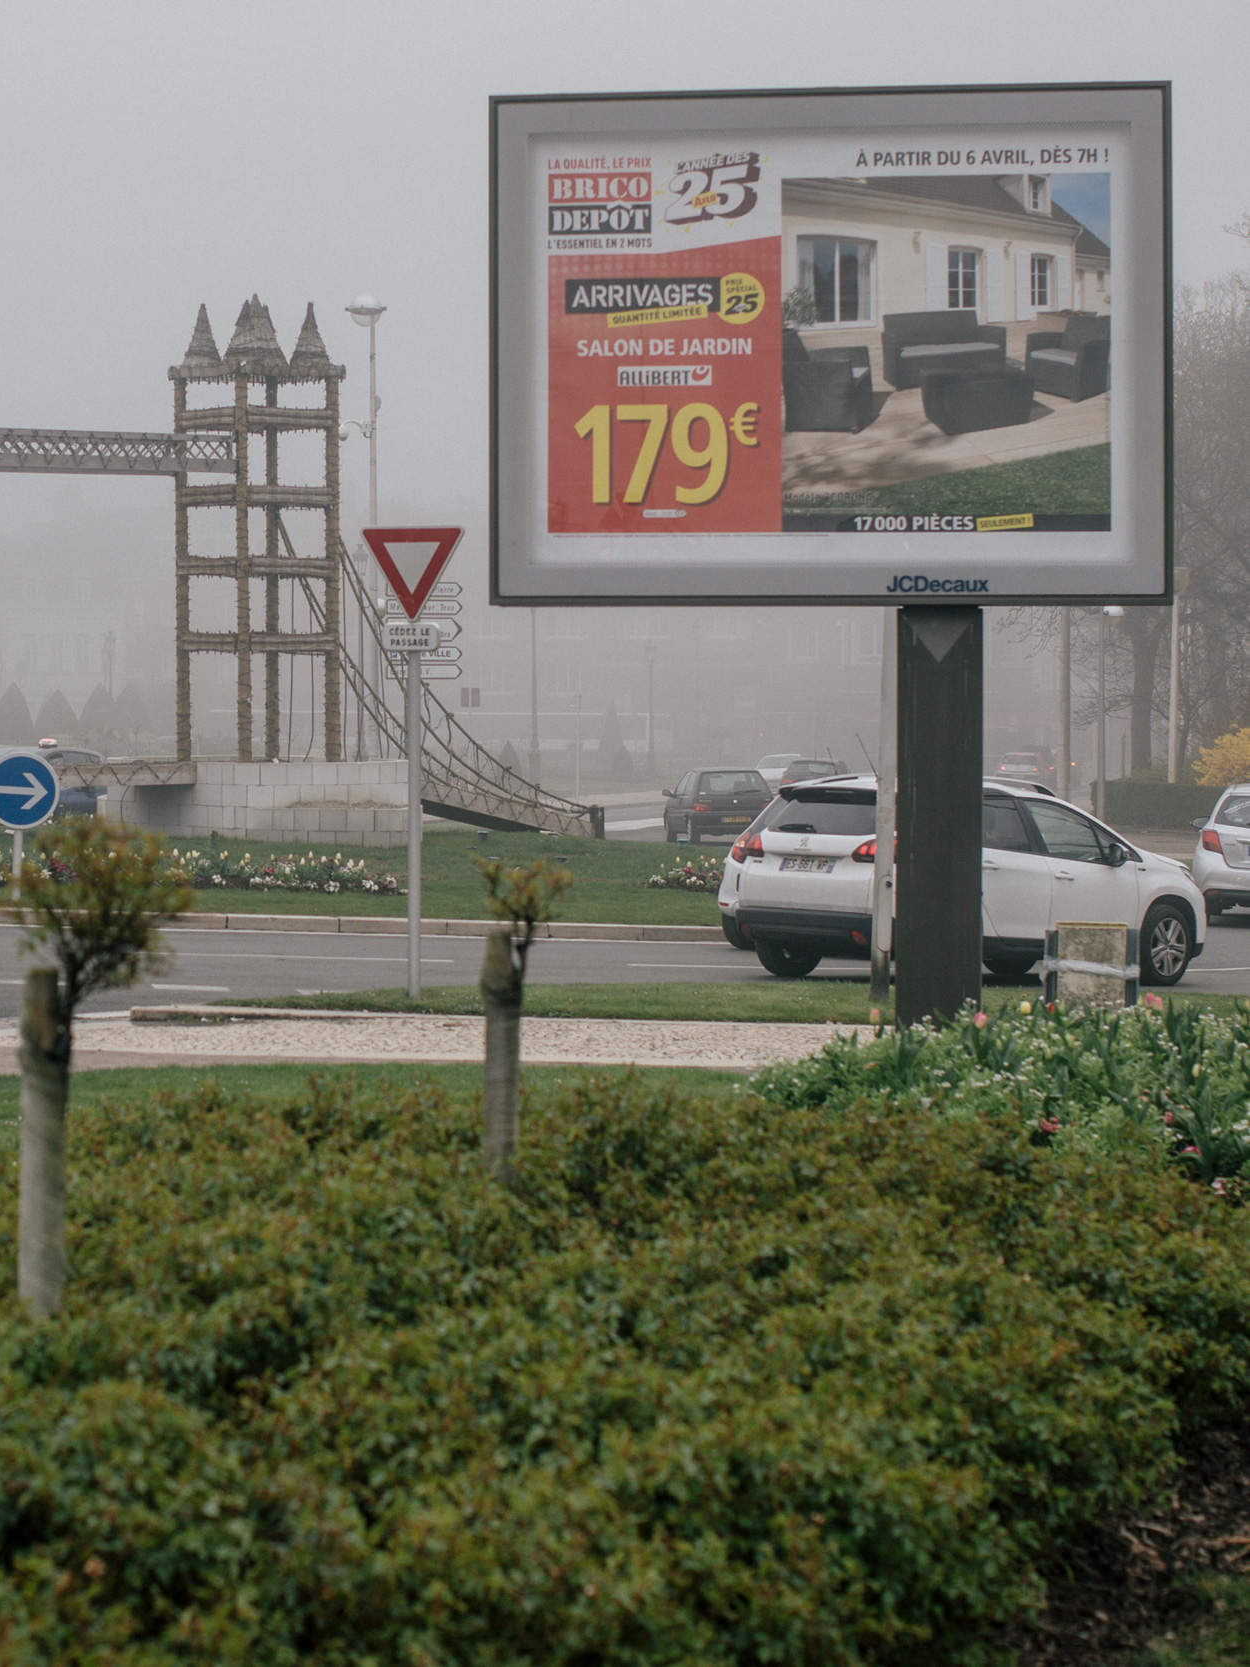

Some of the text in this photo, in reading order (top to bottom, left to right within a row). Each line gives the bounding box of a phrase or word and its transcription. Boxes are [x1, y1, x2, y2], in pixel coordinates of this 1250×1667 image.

[547, 156, 652, 170] LA QUALITÉ, LE PRIX
[674, 151, 751, 173] L'ANNÉE DES
[856, 145, 1110, 168] À PARTIR DU 6 AVRIL, DÈS 7H !
[551, 176, 650, 200] BRICO
[664, 162, 751, 223] 25
[693, 193, 717, 208] Ans
[547, 238, 653, 250] L'ESSENTIEL EN 2 MOTS
[571, 283, 714, 308] ARRIVAGES
[724, 292, 760, 316] 25
[612, 306, 702, 325] QUANTITÉ LIMITÉE
[577, 337, 753, 357] SALON DE JARDIN
[912, 513, 974, 531] PIÈCES
[979, 516, 1026, 529] SEULEMENT
[886, 575, 989, 593] JCDecaux
[440, 603, 455, 611] Tous
[389, 626, 417, 636] CÉDEZ
[420, 627, 431, 636] LE
[390, 638, 430, 647] PASSAGE
[429, 650, 452, 658] VILLE
